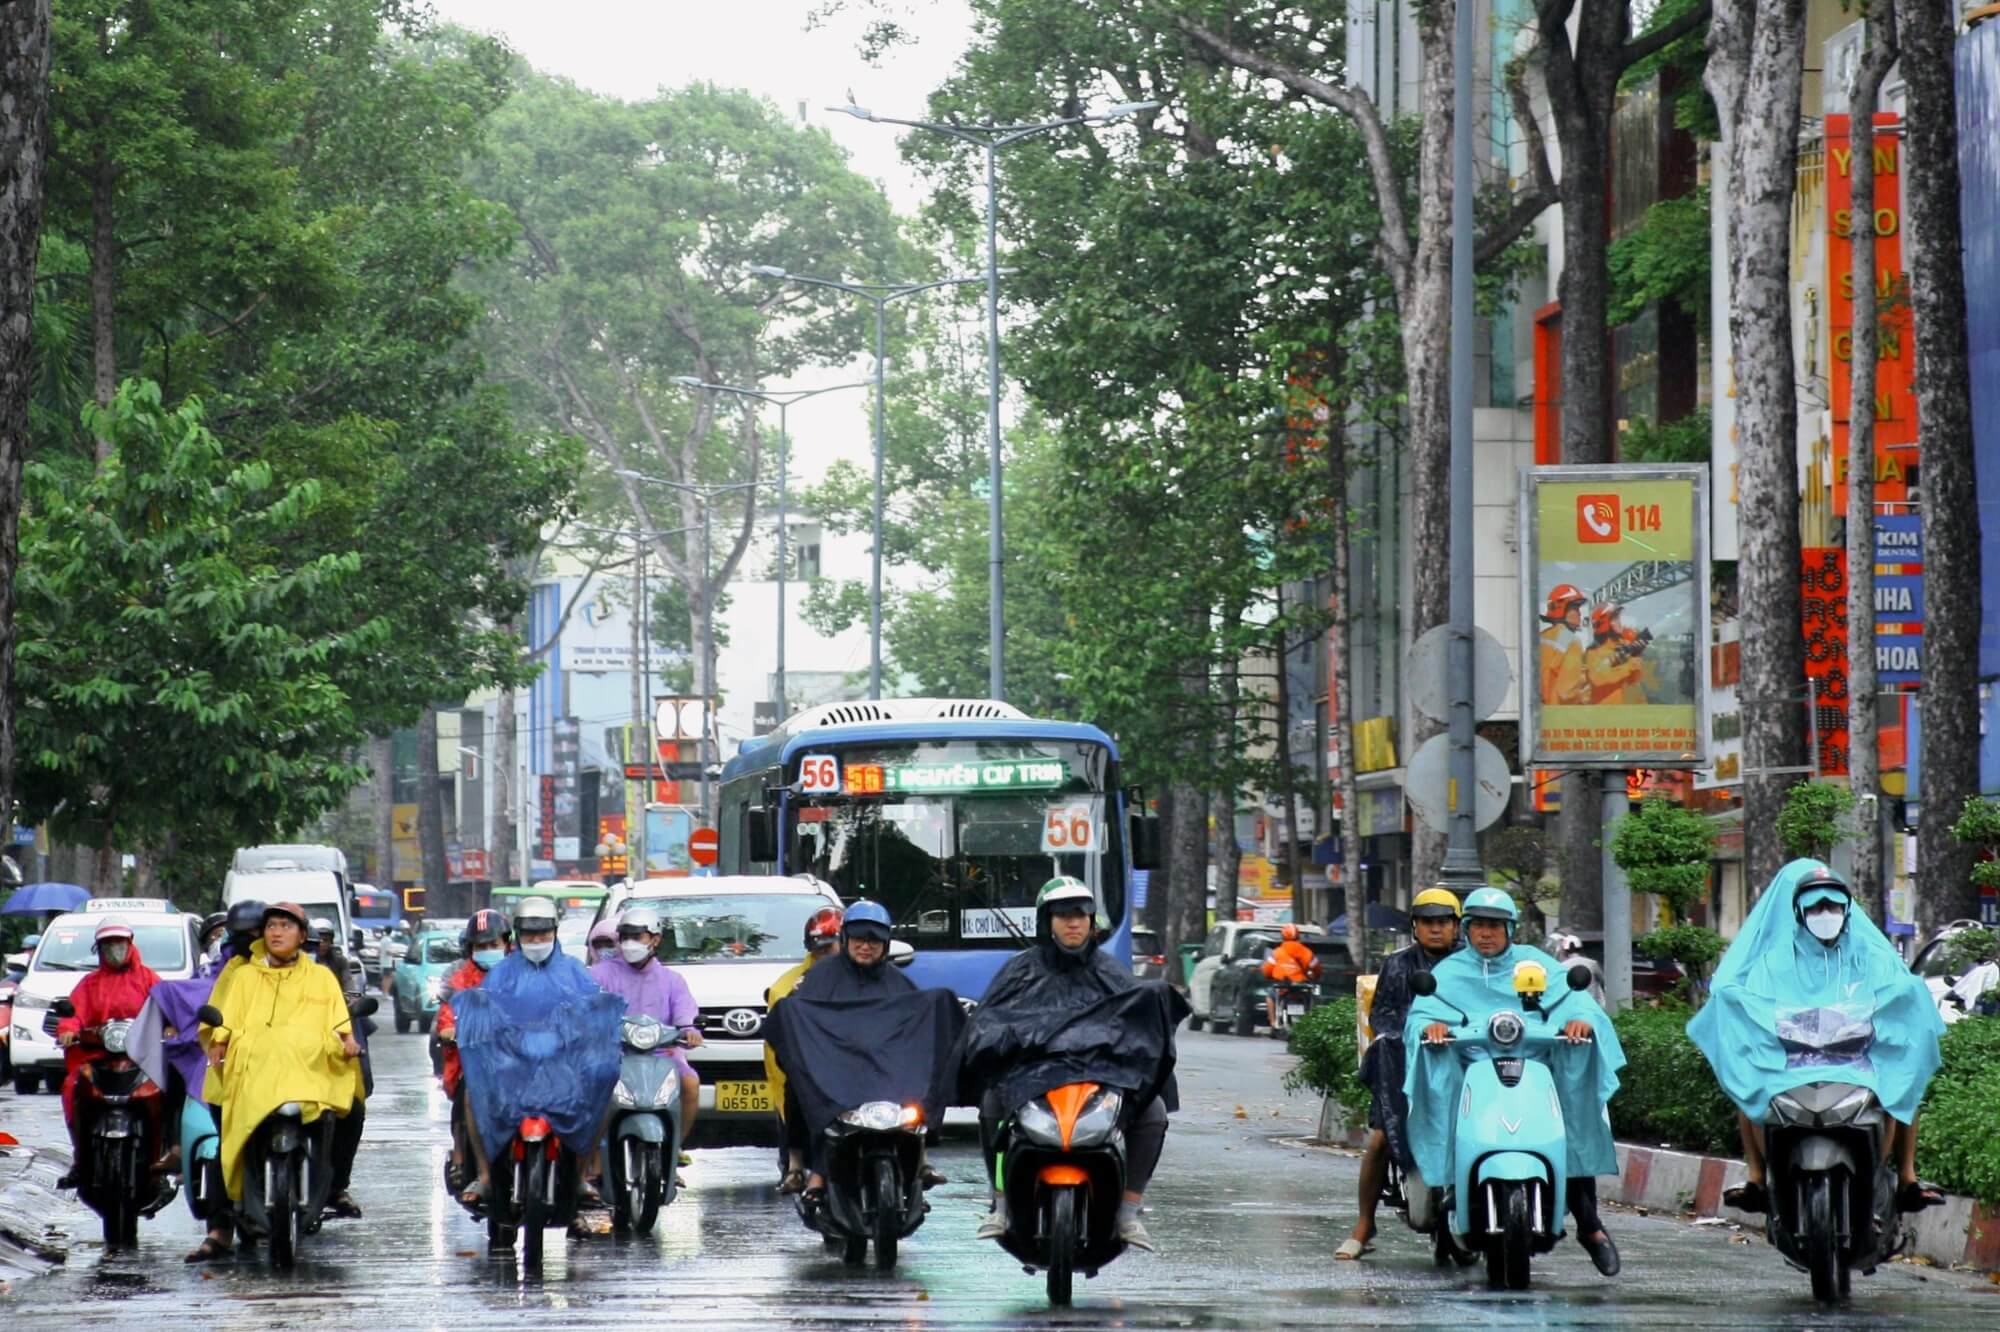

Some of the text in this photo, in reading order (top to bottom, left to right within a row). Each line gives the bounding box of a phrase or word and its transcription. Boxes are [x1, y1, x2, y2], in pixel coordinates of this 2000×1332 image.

[1832, 146, 1896, 177] YN
[1835, 208, 1898, 238] SO
[1833, 332, 1900, 361] GN
[1624, 504, 1661, 532] 114
[1877, 532, 1918, 546] KIM
[1876, 647, 1920, 670] HOA
[802, 759, 834, 788] 56
[846, 766, 880, 792] 56
[1046, 806, 1090, 847] 56
[732, 1084, 757, 1095] 76A
